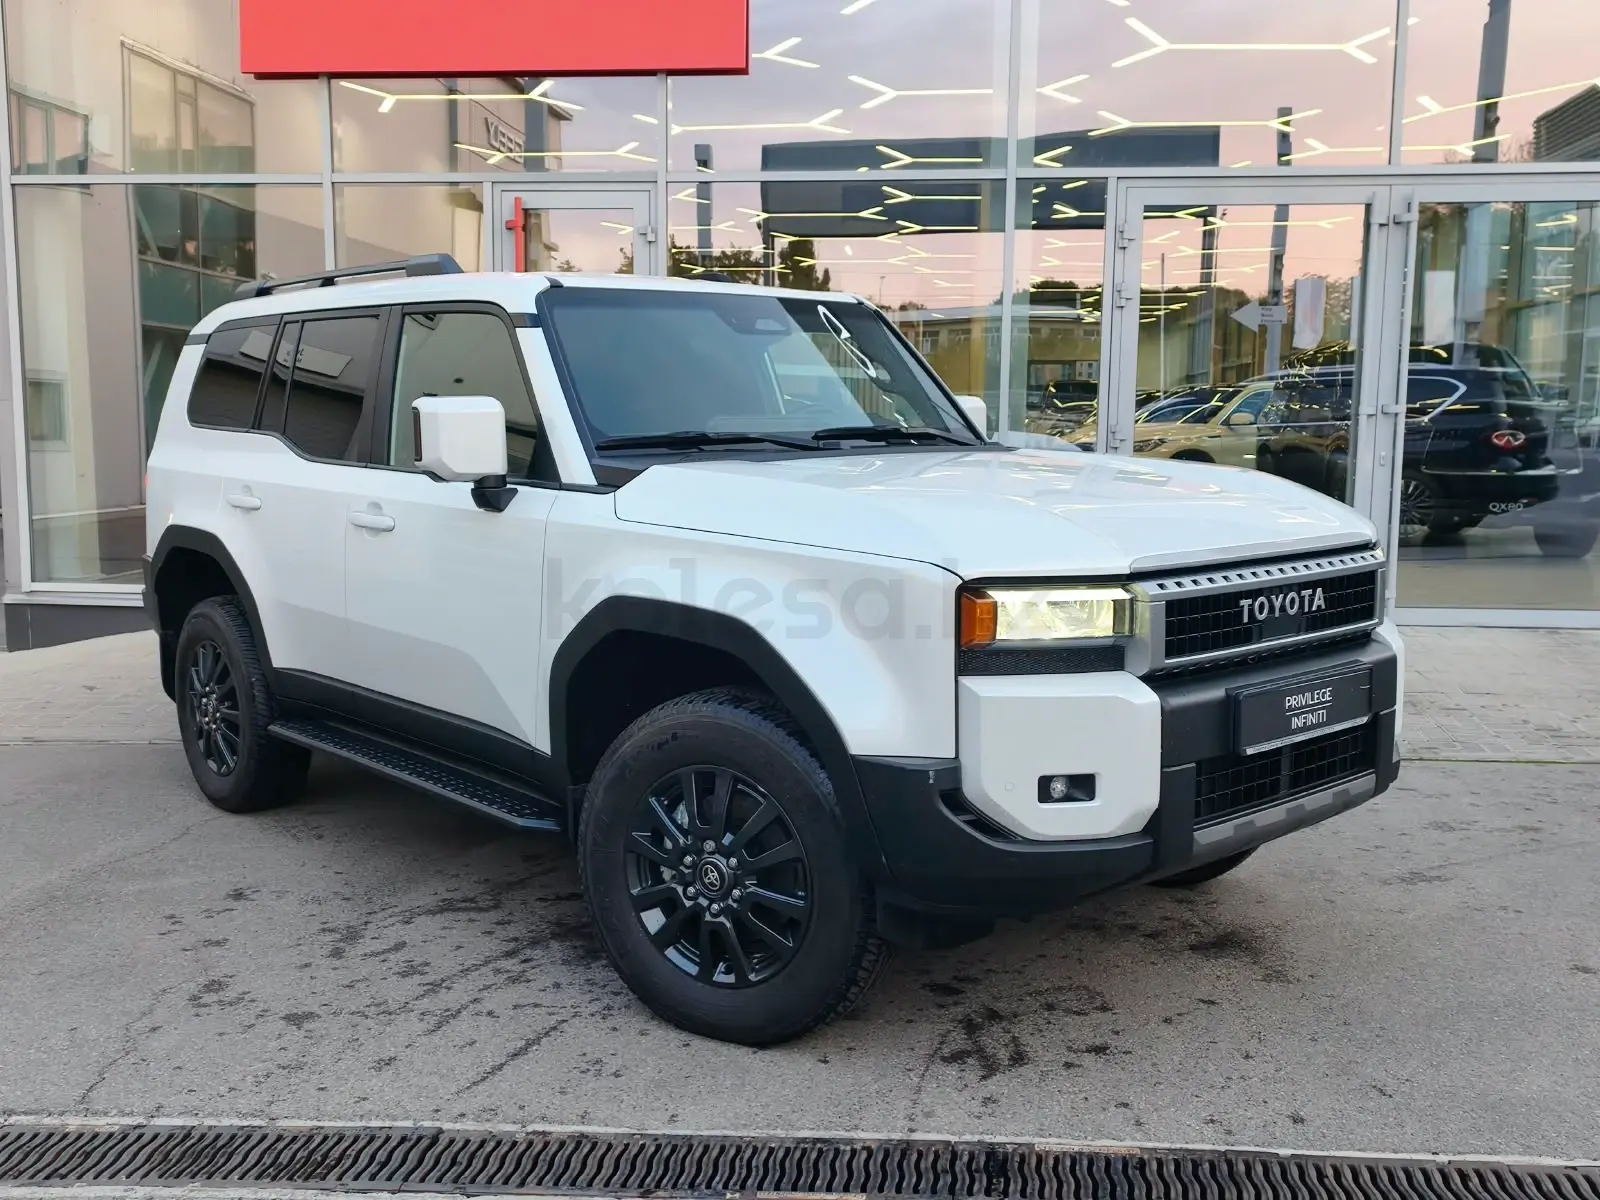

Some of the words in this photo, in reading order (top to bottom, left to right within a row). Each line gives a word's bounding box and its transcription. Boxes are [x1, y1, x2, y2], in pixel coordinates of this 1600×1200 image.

[1240, 588, 1326, 623] TOYOTA
[1286, 687, 1333, 709] PRIVILEGE
[1291, 710, 1326, 729] INFINITI
